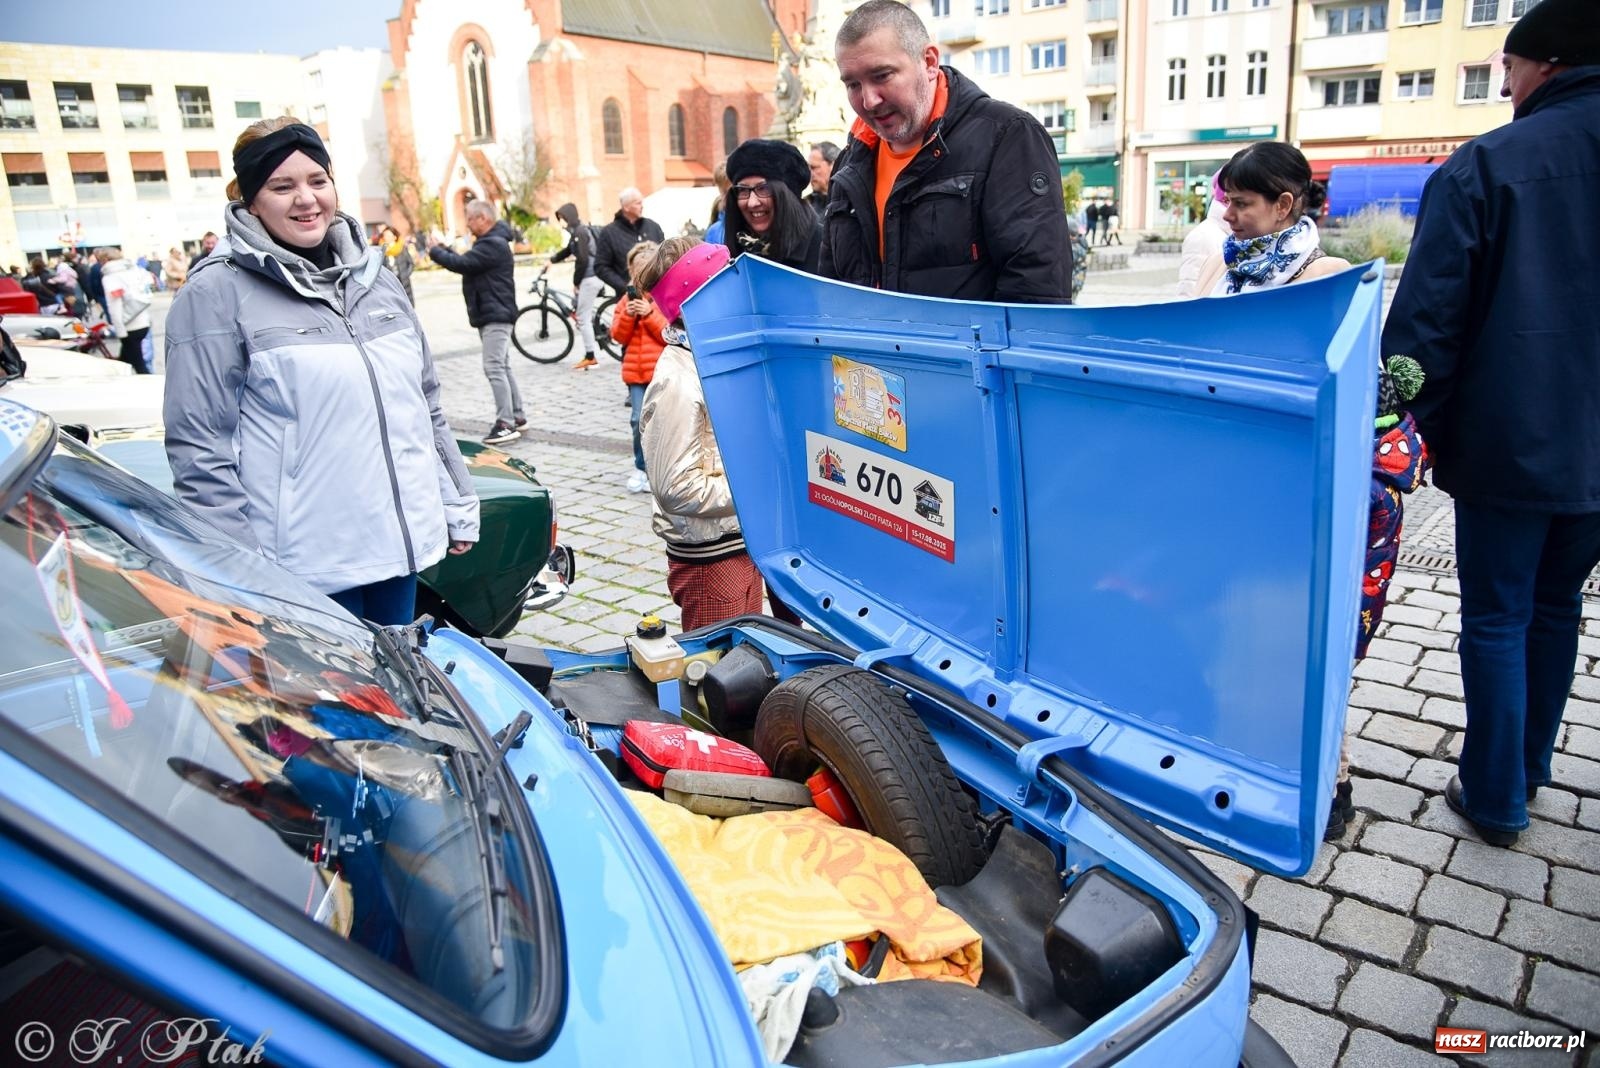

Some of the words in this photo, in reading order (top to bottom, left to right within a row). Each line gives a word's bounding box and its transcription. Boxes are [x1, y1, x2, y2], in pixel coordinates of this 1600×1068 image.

[887, 391, 902, 425] 31
[857, 462, 902, 505] 670
[821, 493, 863, 515] OGÓLNOPOLSKI
[863, 510, 878, 522] ZLOT
[877, 516, 893, 529] FIATA
[893, 523, 903, 532] 126
